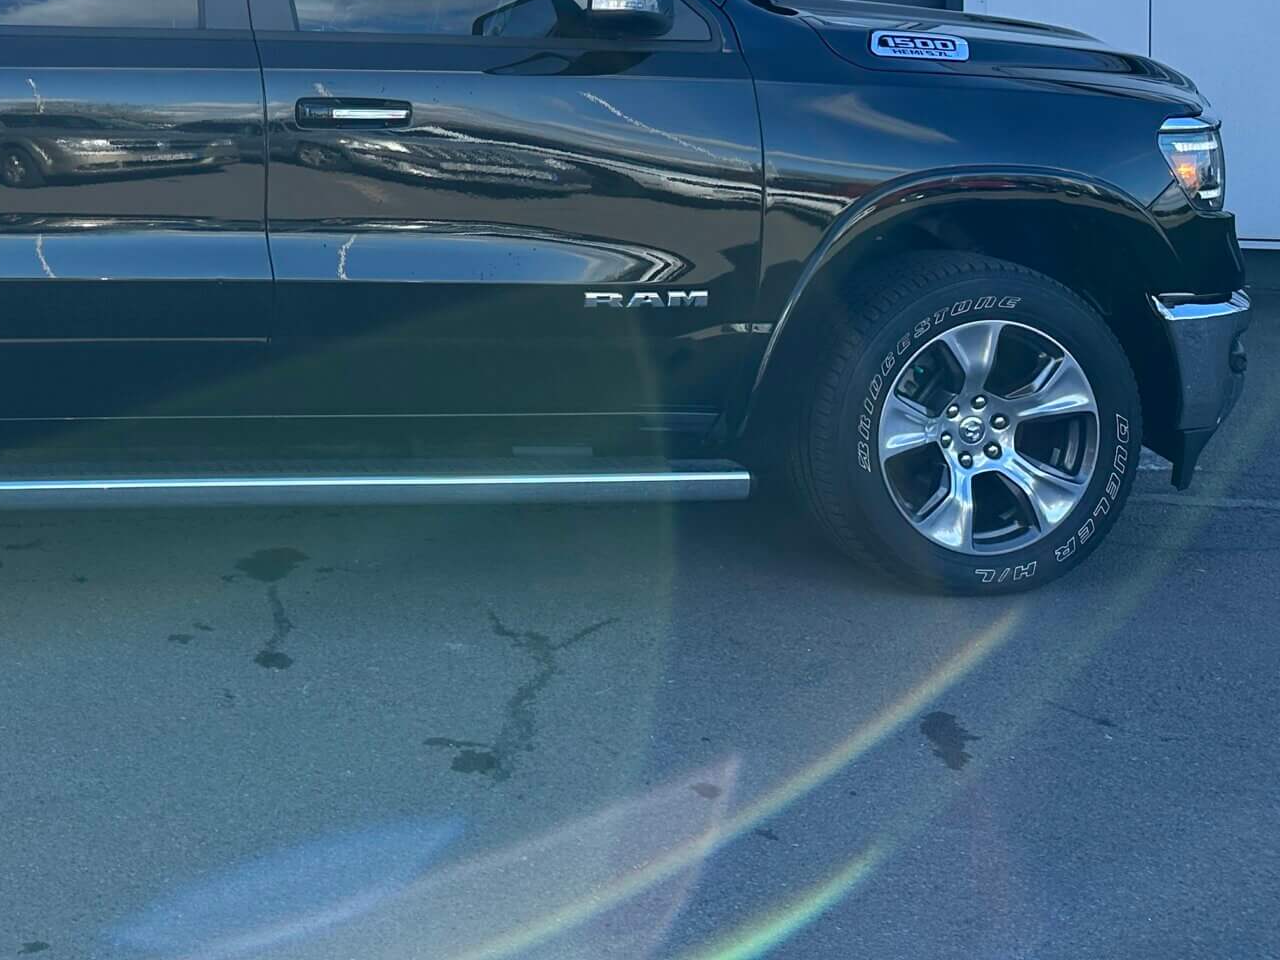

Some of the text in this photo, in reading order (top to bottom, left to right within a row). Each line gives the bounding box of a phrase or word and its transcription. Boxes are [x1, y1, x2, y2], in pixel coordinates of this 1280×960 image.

[879, 36, 955, 50] 1500
[583, 290, 709, 308] RAM
[857, 295, 1021, 472] BRIDGESTONE
[1054, 413, 1130, 563] DUELER
